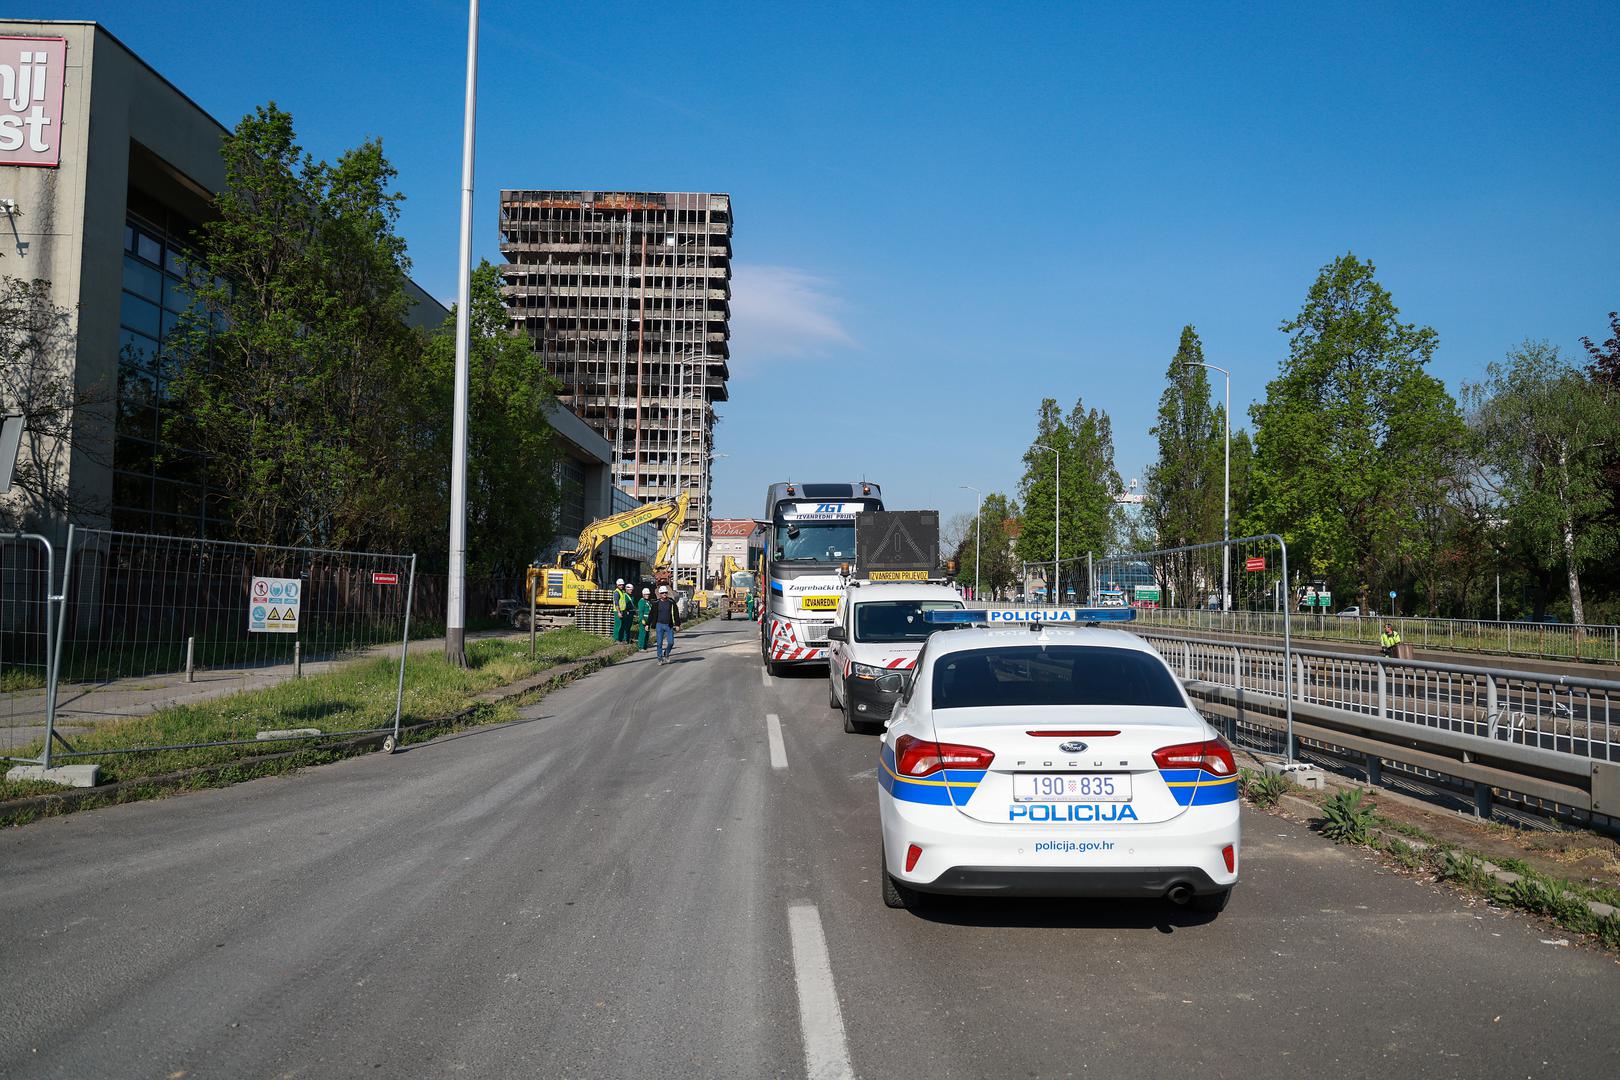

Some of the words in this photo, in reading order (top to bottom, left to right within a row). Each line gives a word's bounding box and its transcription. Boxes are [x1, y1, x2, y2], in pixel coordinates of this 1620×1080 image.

[0, 105, 51, 152] st
[815, 504, 845, 513] ZGT
[870, 571, 900, 580] IZVANREDNI
[902, 571, 928, 580] PRIJEVOZ
[805, 598, 836, 607] IZVANREDNI
[991, 611, 1072, 621] POLICIJA
[1033, 777, 1064, 795] 190
[1081, 777, 1114, 795] 835
[1009, 804, 1139, 821] POLICIJA
[1035, 841, 1115, 852] policija.gov.hr
